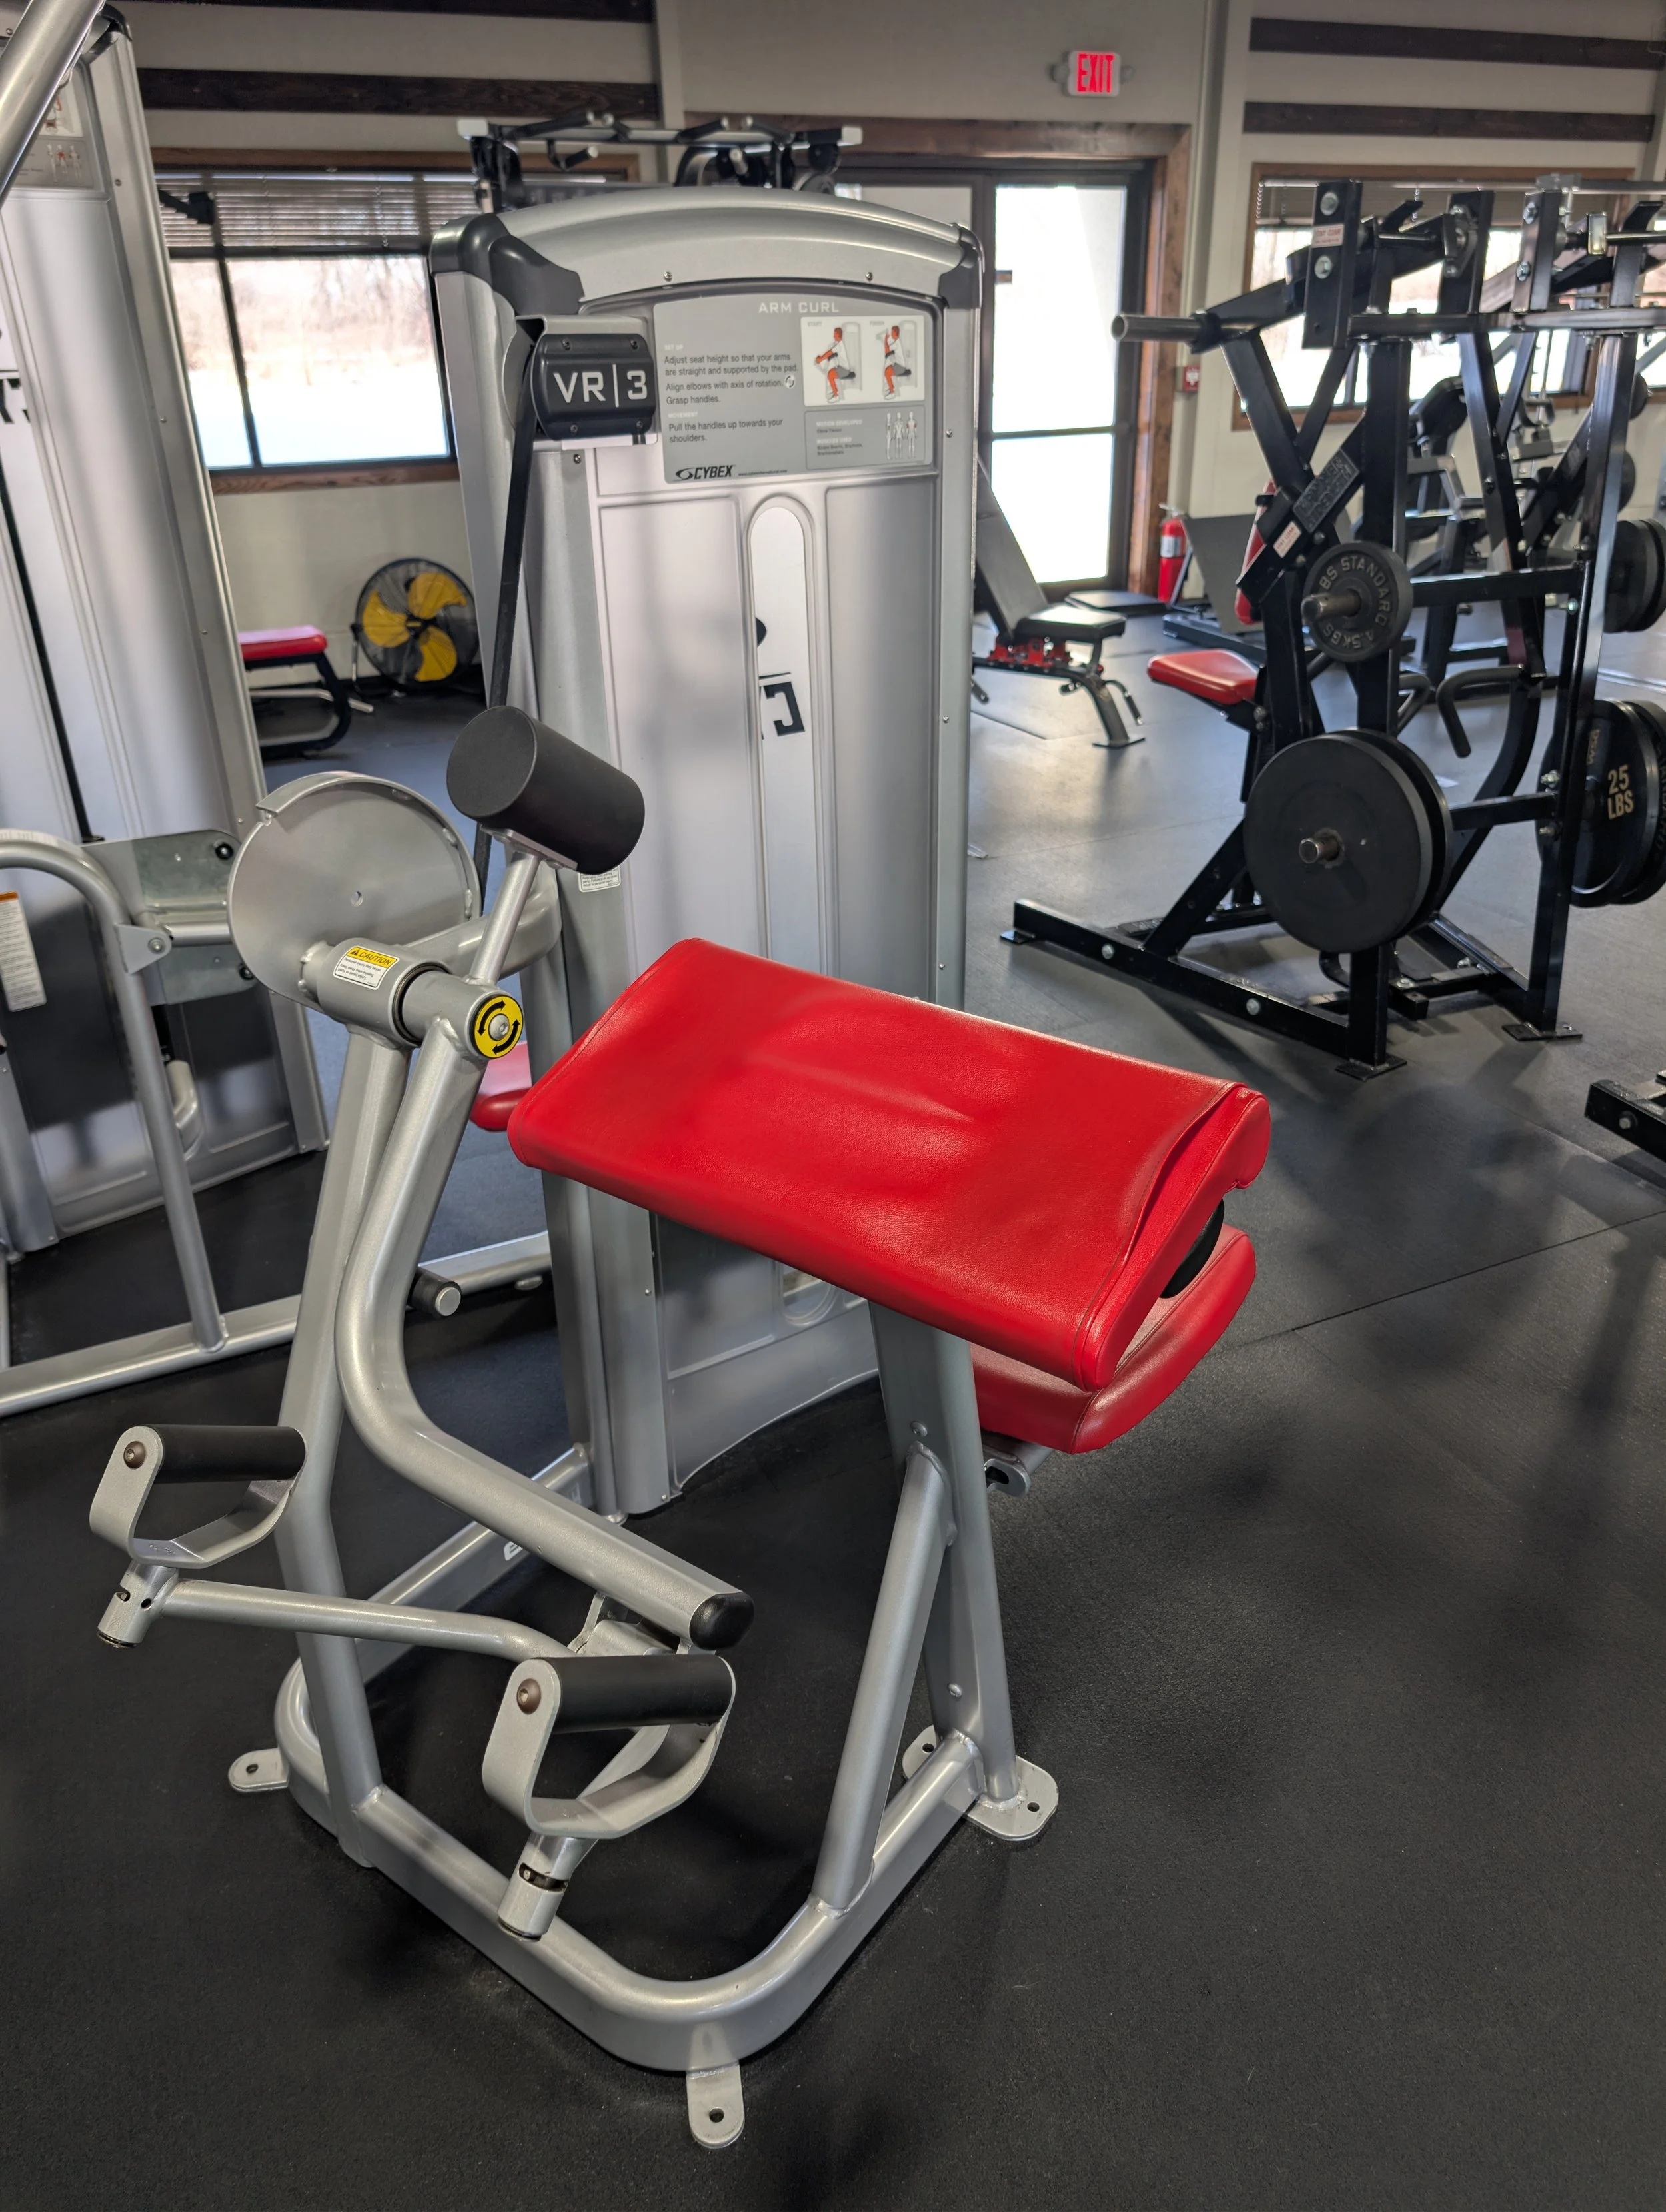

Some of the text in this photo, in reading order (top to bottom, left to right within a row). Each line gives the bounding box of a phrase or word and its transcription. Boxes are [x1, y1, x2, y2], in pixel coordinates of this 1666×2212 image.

[1078, 53, 1114, 93] EXIT
[758, 302, 840, 314] ARM CURL
[664, 356, 687, 366] Adjust
[706, 354, 728, 364] height
[678, 367, 706, 377] straight
[723, 366, 759, 376] supported
[761, 365, 769, 374] by
[784, 364, 798, 373] pad.
[666, 383, 684, 393] Align
[686, 382, 712, 390] elbows
[755, 379, 782, 388] rotation.
[666, 395, 720, 406] Grasp handles.
[669, 422, 683, 432] Pull
[684, 422, 696, 431] the
[698, 421, 726, 430] handles
[739, 420, 766, 428] towards
[768, 419, 783, 428] your
[669, 434, 707, 443] shoulders.
[694, 465, 734, 480] CYBEX
[1340, 555, 1391, 626] STANDARD
[1607, 764, 1629, 795] 25
[1607, 790, 1633, 820] LBS
[359, 952, 392, 965] CAUTION
